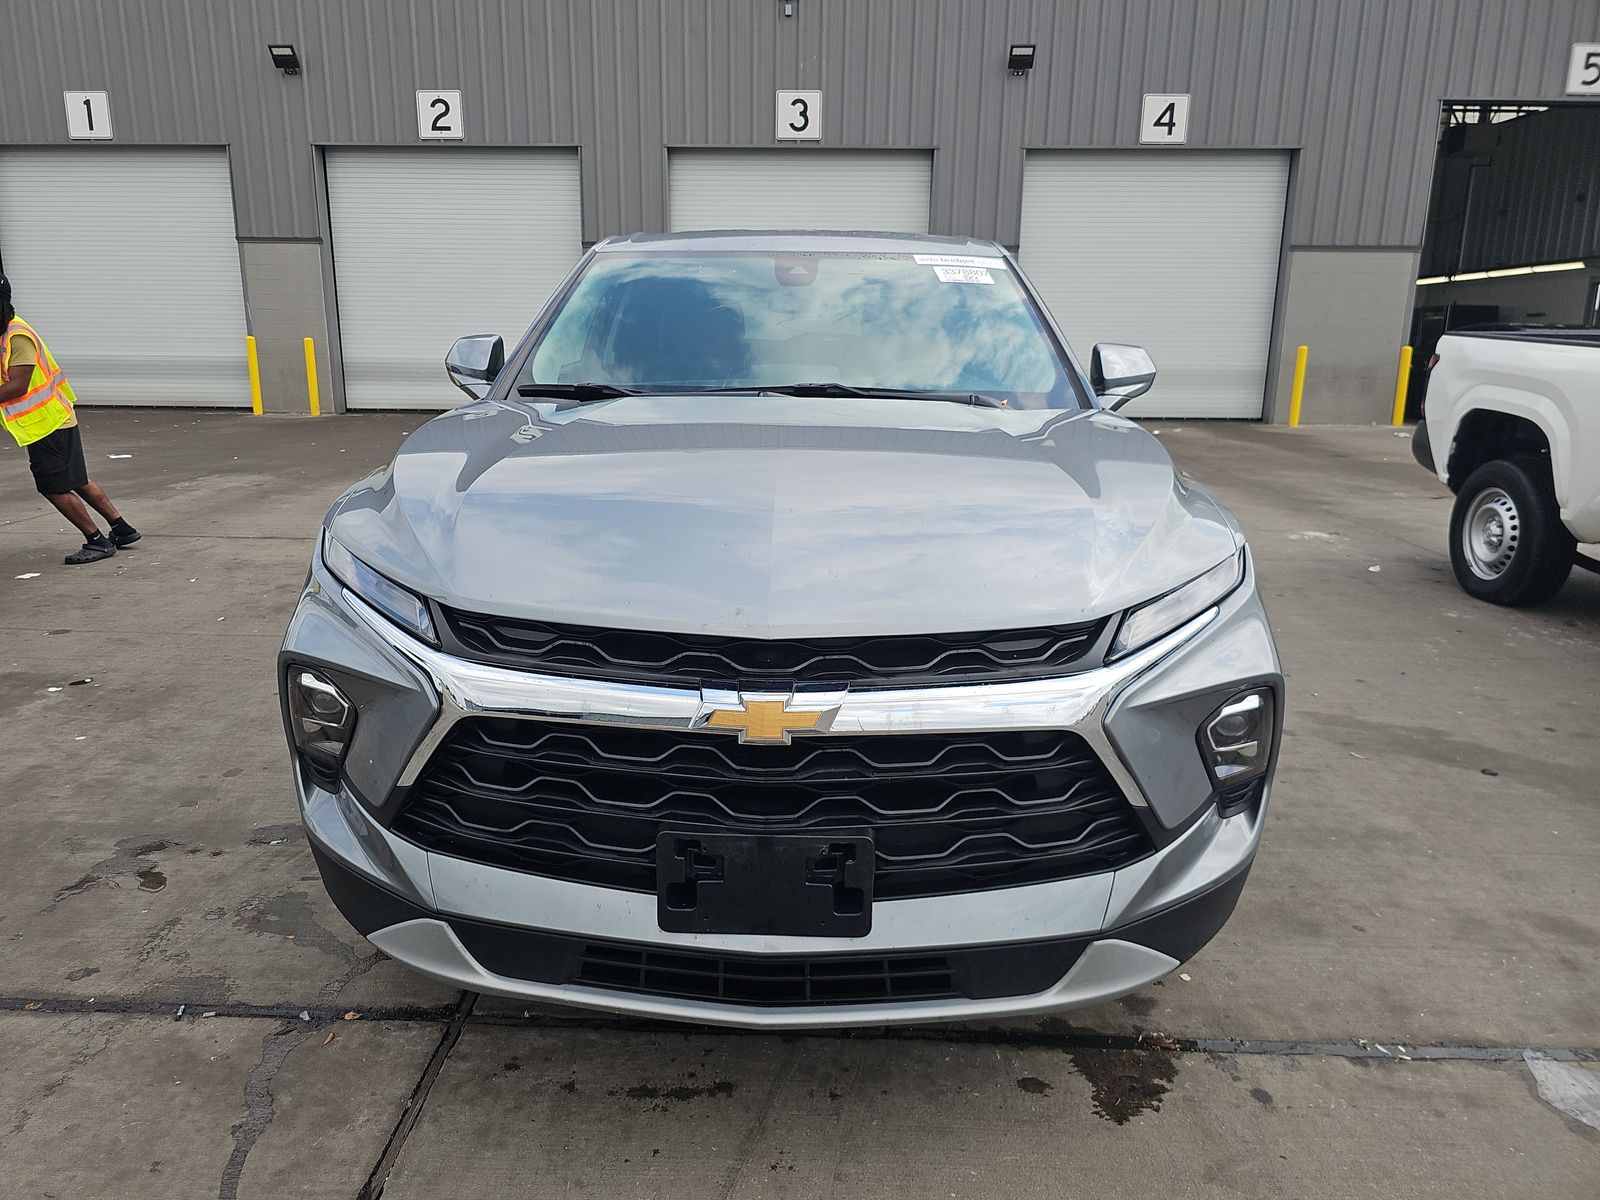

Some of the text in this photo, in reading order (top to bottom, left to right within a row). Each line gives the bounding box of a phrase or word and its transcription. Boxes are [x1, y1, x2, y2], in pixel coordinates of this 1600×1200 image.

[1581, 52, 1600, 86] 5
[83, 98, 94, 132] 1
[430, 98, 452, 132] 2
[788, 98, 809, 133] 3
[1153, 103, 1177, 136] 4
